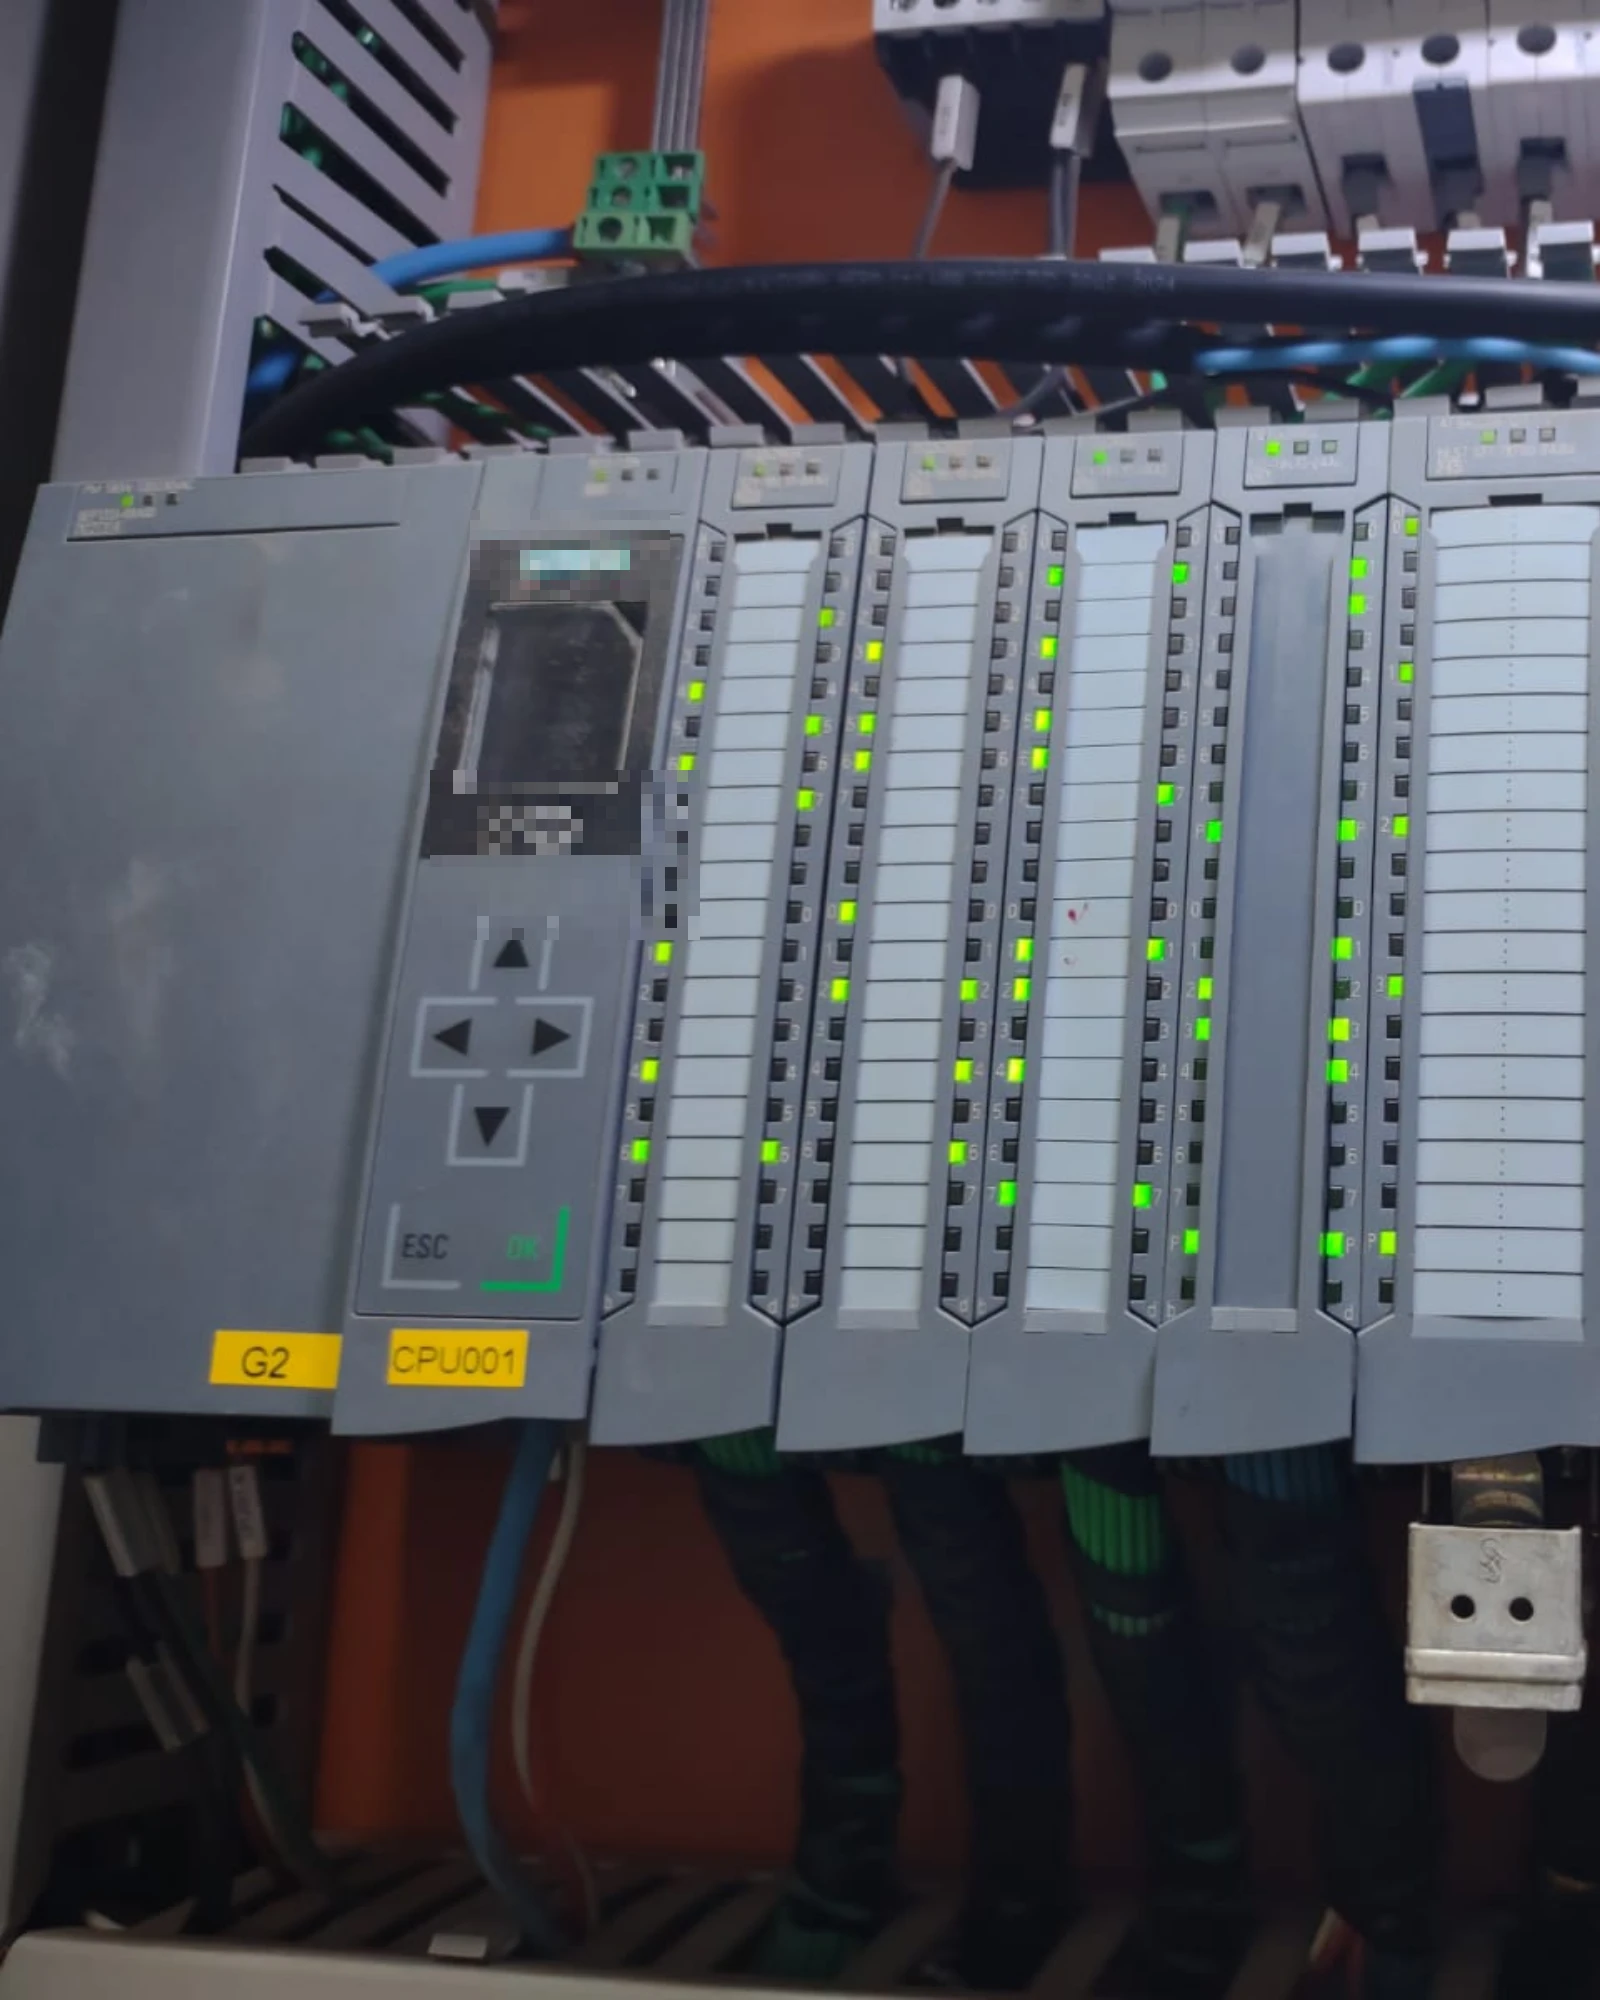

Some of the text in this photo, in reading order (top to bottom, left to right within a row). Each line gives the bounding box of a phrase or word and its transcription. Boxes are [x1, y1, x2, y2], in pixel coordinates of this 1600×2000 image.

[1361, 706, 1369, 721] 5
[1000, 751, 1008, 766] 6
[1360, 744, 1368, 760] 6
[1380, 816, 1389, 832] 2
[802, 907, 811, 922] 0
[987, 903, 996, 919] 0
[1008, 903, 1017, 919] 0
[1168, 902, 1177, 918] 0
[1190, 902, 1200, 918] 0
[1354, 900, 1363, 916] 0
[641, 984, 650, 1000] 2
[794, 984, 804, 1000] 2
[980, 982, 989, 998] 2
[1001, 982, 1010, 998] 2
[1162, 982, 1171, 998] 2
[1186, 982, 1195, 998] 2
[1351, 981, 1360, 998] 2
[1375, 976, 1384, 992] 3
[791, 1024, 800, 1040] 3
[978, 1022, 987, 1038] 3
[1000, 1022, 1008, 1038] 3
[1160, 1022, 1169, 1039] 3
[1184, 1022, 1193, 1038] 3
[1351, 1022, 1359, 1038] 3
[787, 1064, 796, 1080] 4
[996, 1062, 1005, 1078] 4
[1158, 1063, 1168, 1079] 4
[1180, 1062, 1190, 1079] 4
[1350, 1063, 1359, 1079] 4
[626, 1104, 636, 1120] 5
[783, 1104, 793, 1121] 5
[806, 1101, 816, 1117] 5
[972, 1102, 981, 1119] 5
[993, 1102, 1002, 1119] 5
[1157, 1104, 1165, 1121] 5
[1178, 1104, 1187, 1120] 5
[1349, 1105, 1357, 1121] 5
[969, 1144, 978, 1161] 6
[990, 1144, 998, 1161] 6
[1175, 1146, 1184, 1163] 6
[1348, 1148, 1357, 1164] 6
[778, 1187, 787, 1204] 7
[967, 1185, 976, 1201] 7
[1153, 1188, 1162, 1204] 7
[1173, 1188, 1182, 1205] 7
[1348, 1189, 1356, 1206] 7
[402, 1233, 450, 1260] ESC
[508, 1236, 540, 1260] OK
[1346, 1237, 1354, 1254] P
[1368, 1233, 1376, 1249] P
[241, 1346, 290, 1379] G2
[392, 1346, 515, 1375] CPU001
